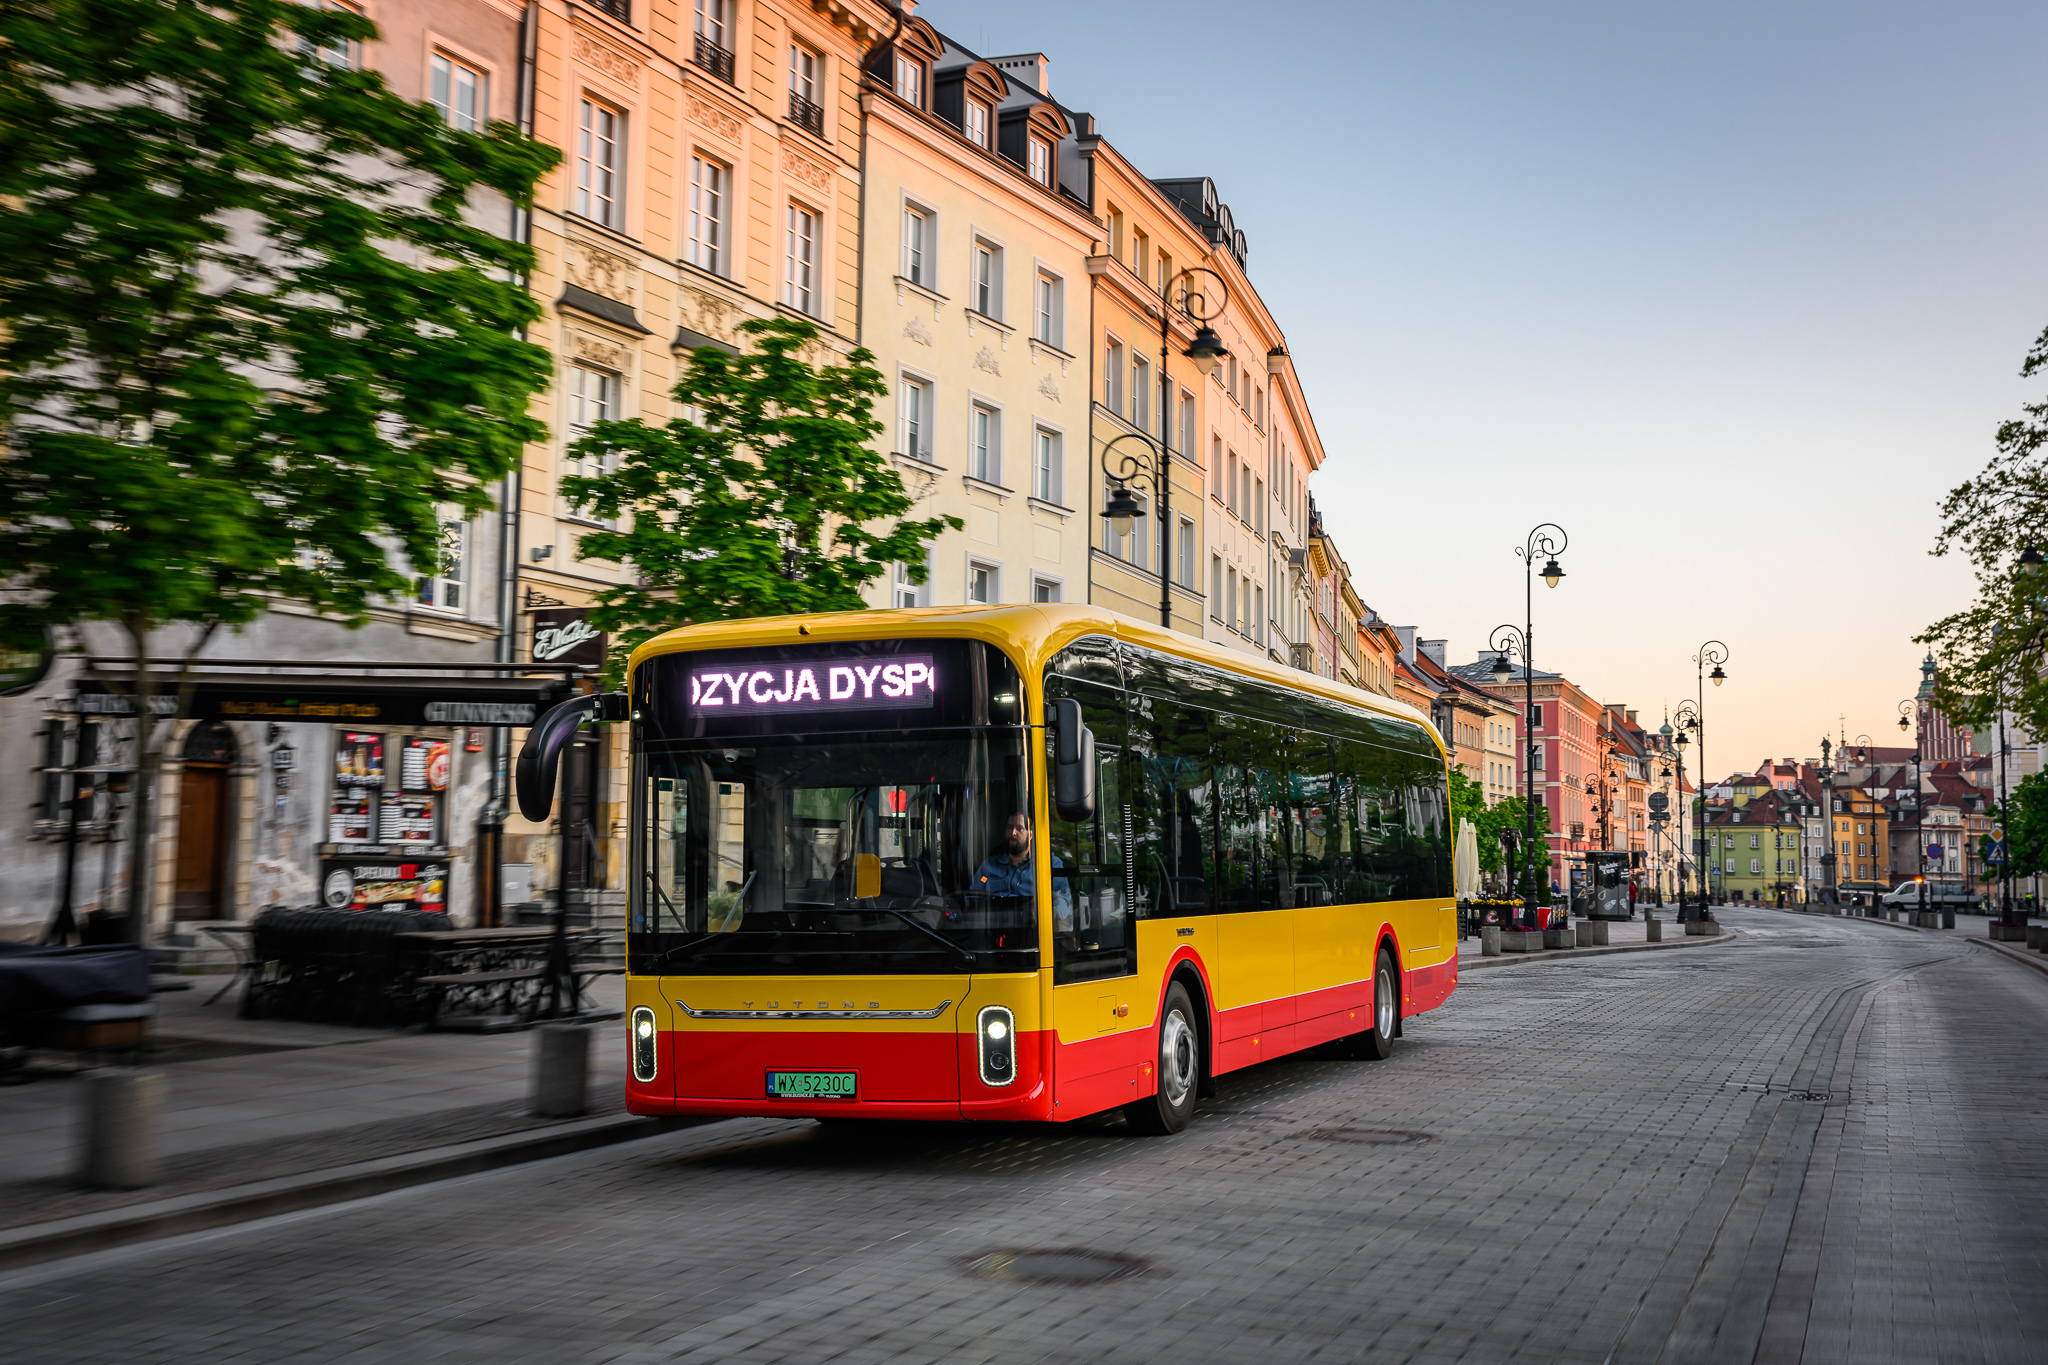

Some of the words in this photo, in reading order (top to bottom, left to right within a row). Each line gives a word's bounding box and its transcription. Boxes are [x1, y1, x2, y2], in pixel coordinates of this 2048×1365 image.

[829, 663, 934, 699] DYSP
[424, 702, 536, 723] GUINNESS
[778, 1075, 797, 1092] WX
[804, 1075, 851, 1092] 5230C
